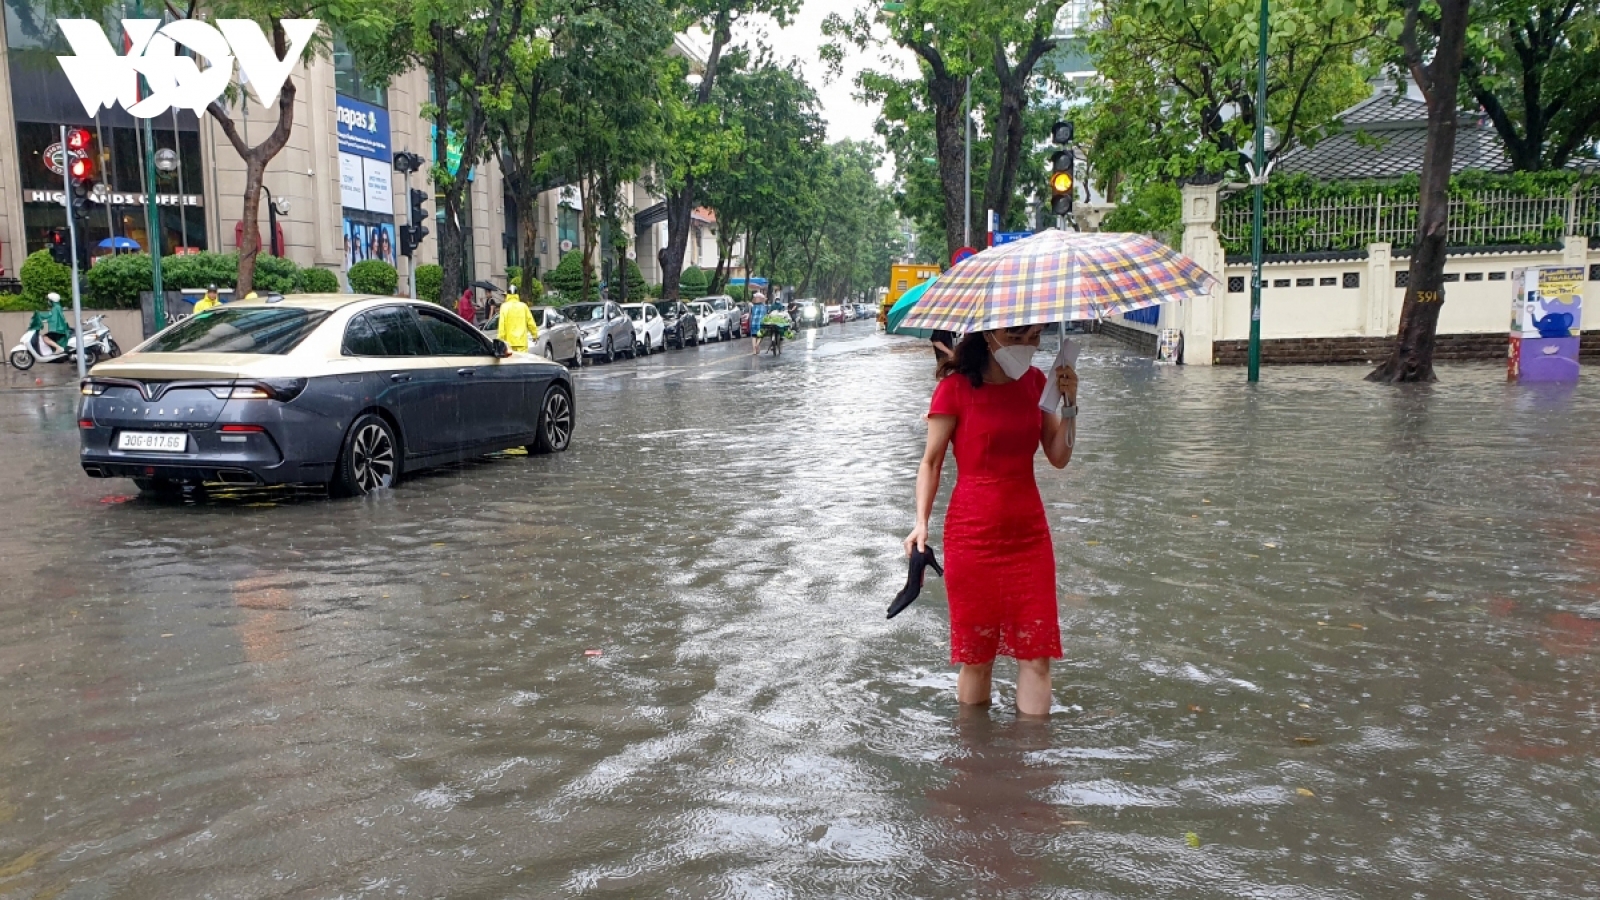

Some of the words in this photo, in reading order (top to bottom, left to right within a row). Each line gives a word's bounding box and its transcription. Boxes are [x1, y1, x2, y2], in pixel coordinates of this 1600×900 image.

[337, 106, 367, 131] napas
[32, 191, 134, 204] HIGANDS
[1417, 290, 1437, 302] 391
[110, 406, 195, 415] VINFAST
